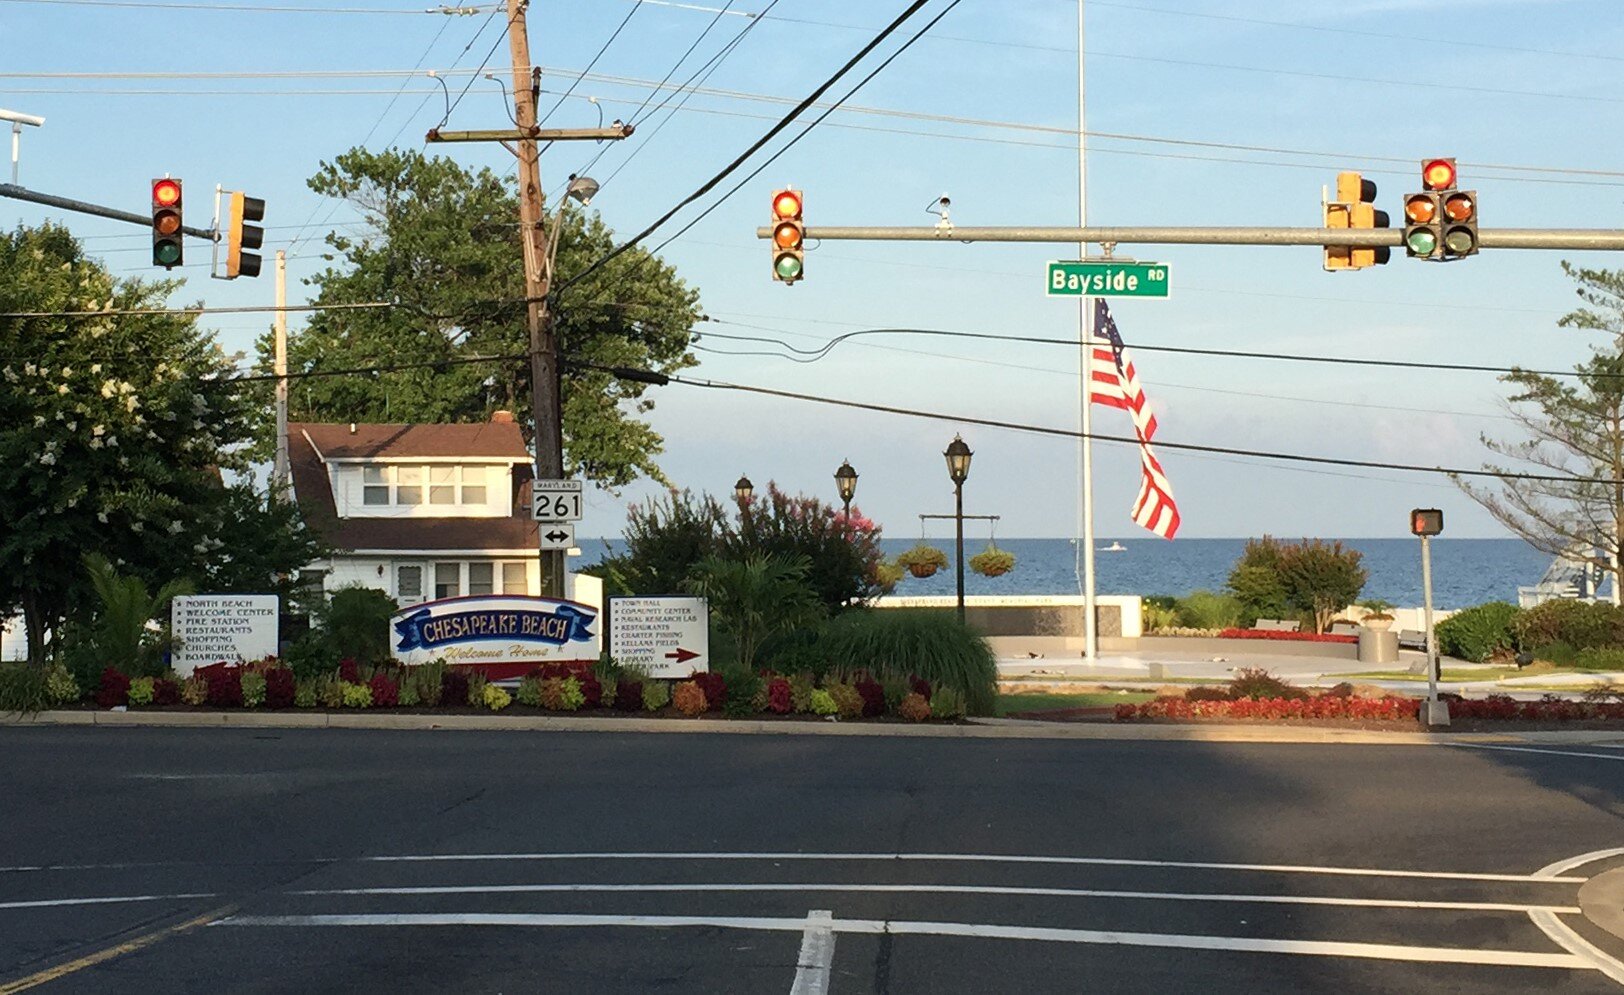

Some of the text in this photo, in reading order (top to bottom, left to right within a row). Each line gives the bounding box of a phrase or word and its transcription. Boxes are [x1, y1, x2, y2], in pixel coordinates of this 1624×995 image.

[1052, 269, 1165, 295] Bayside RD
[536, 495, 578, 517] 261
[423, 614, 568, 643] CHESAPEAKE BEACH
[185, 644, 237, 652] CHURCHES
[186, 635, 232, 643] SHOPPING
[443, 644, 549, 659] Welcome Home
